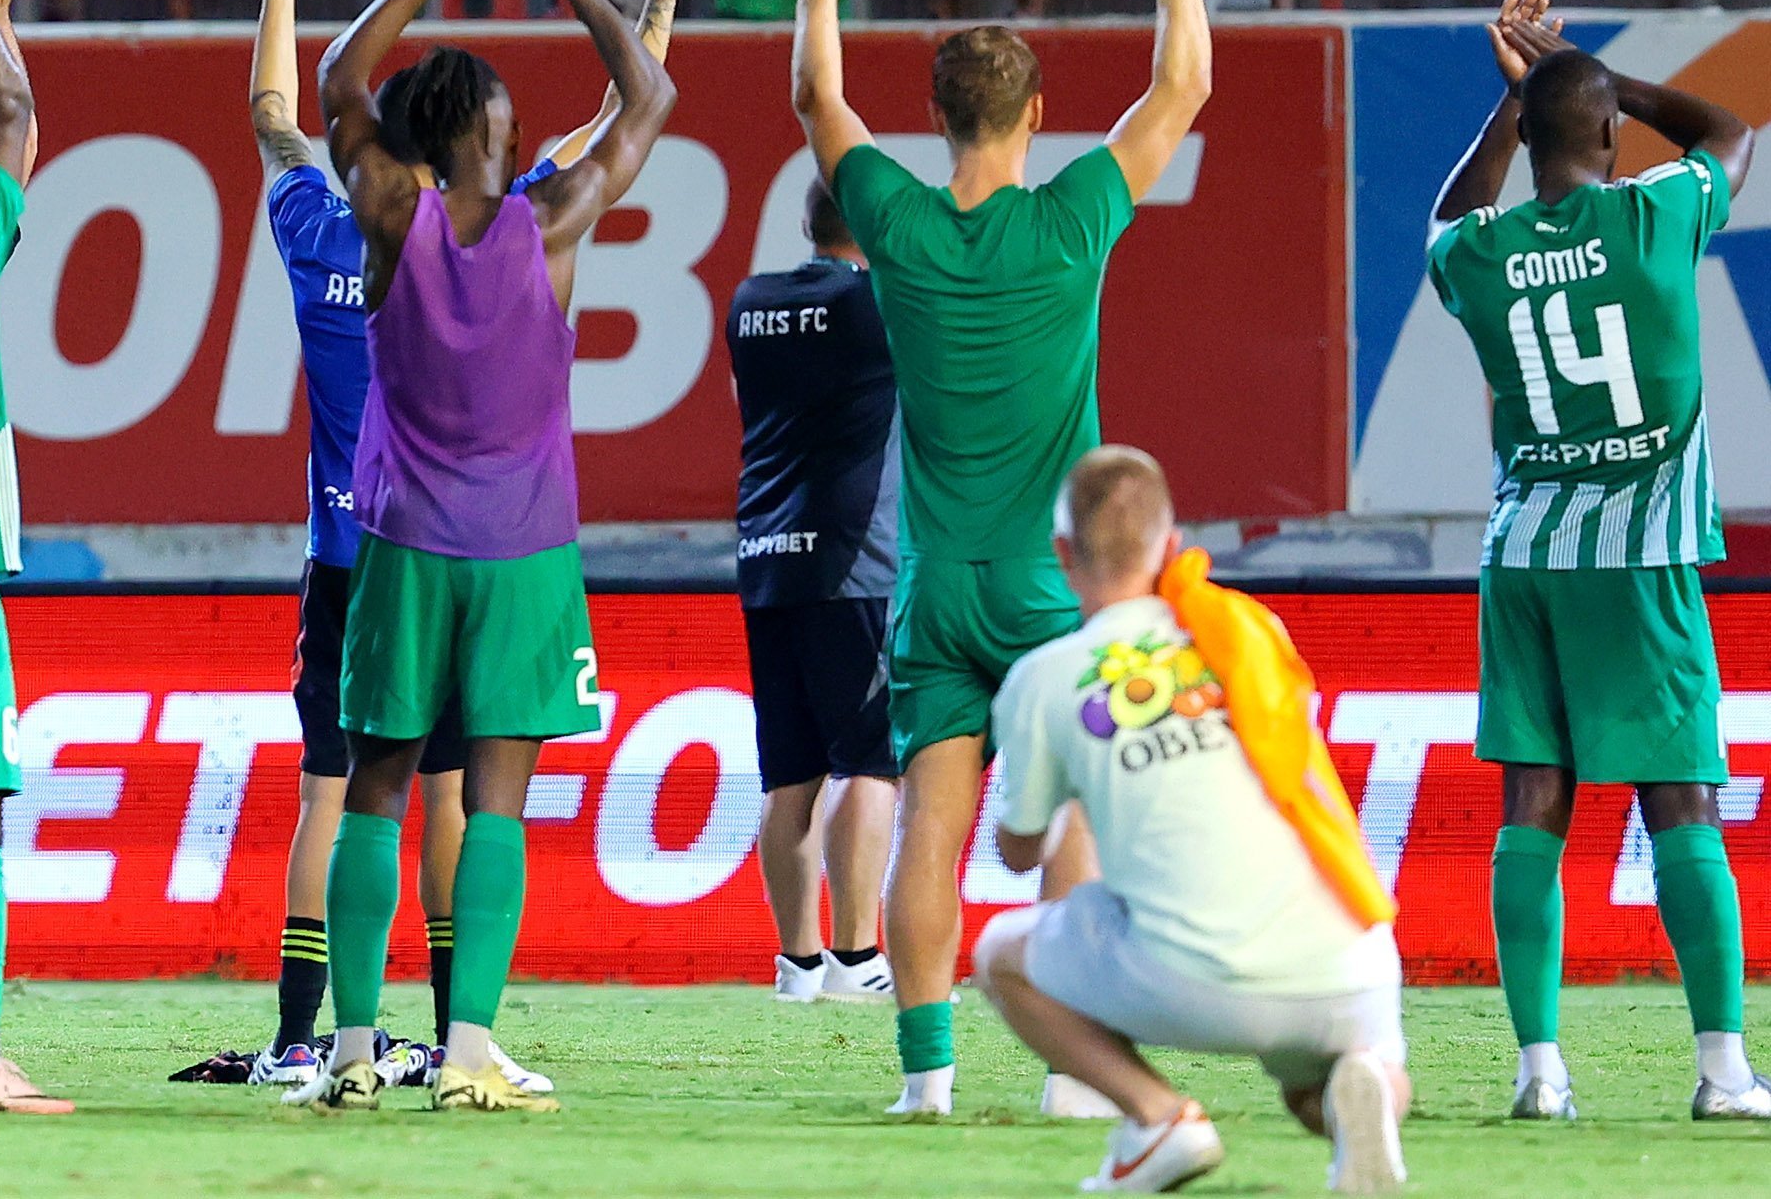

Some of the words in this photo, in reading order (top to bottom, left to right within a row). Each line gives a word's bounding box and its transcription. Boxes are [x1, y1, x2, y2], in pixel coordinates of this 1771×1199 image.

[1505, 237, 1608, 290] GOMIS
[324, 272, 365, 306] AR
[738, 311, 790, 338] ARIS
[799, 307, 829, 333] FC
[1507, 289, 1645, 436] 14
